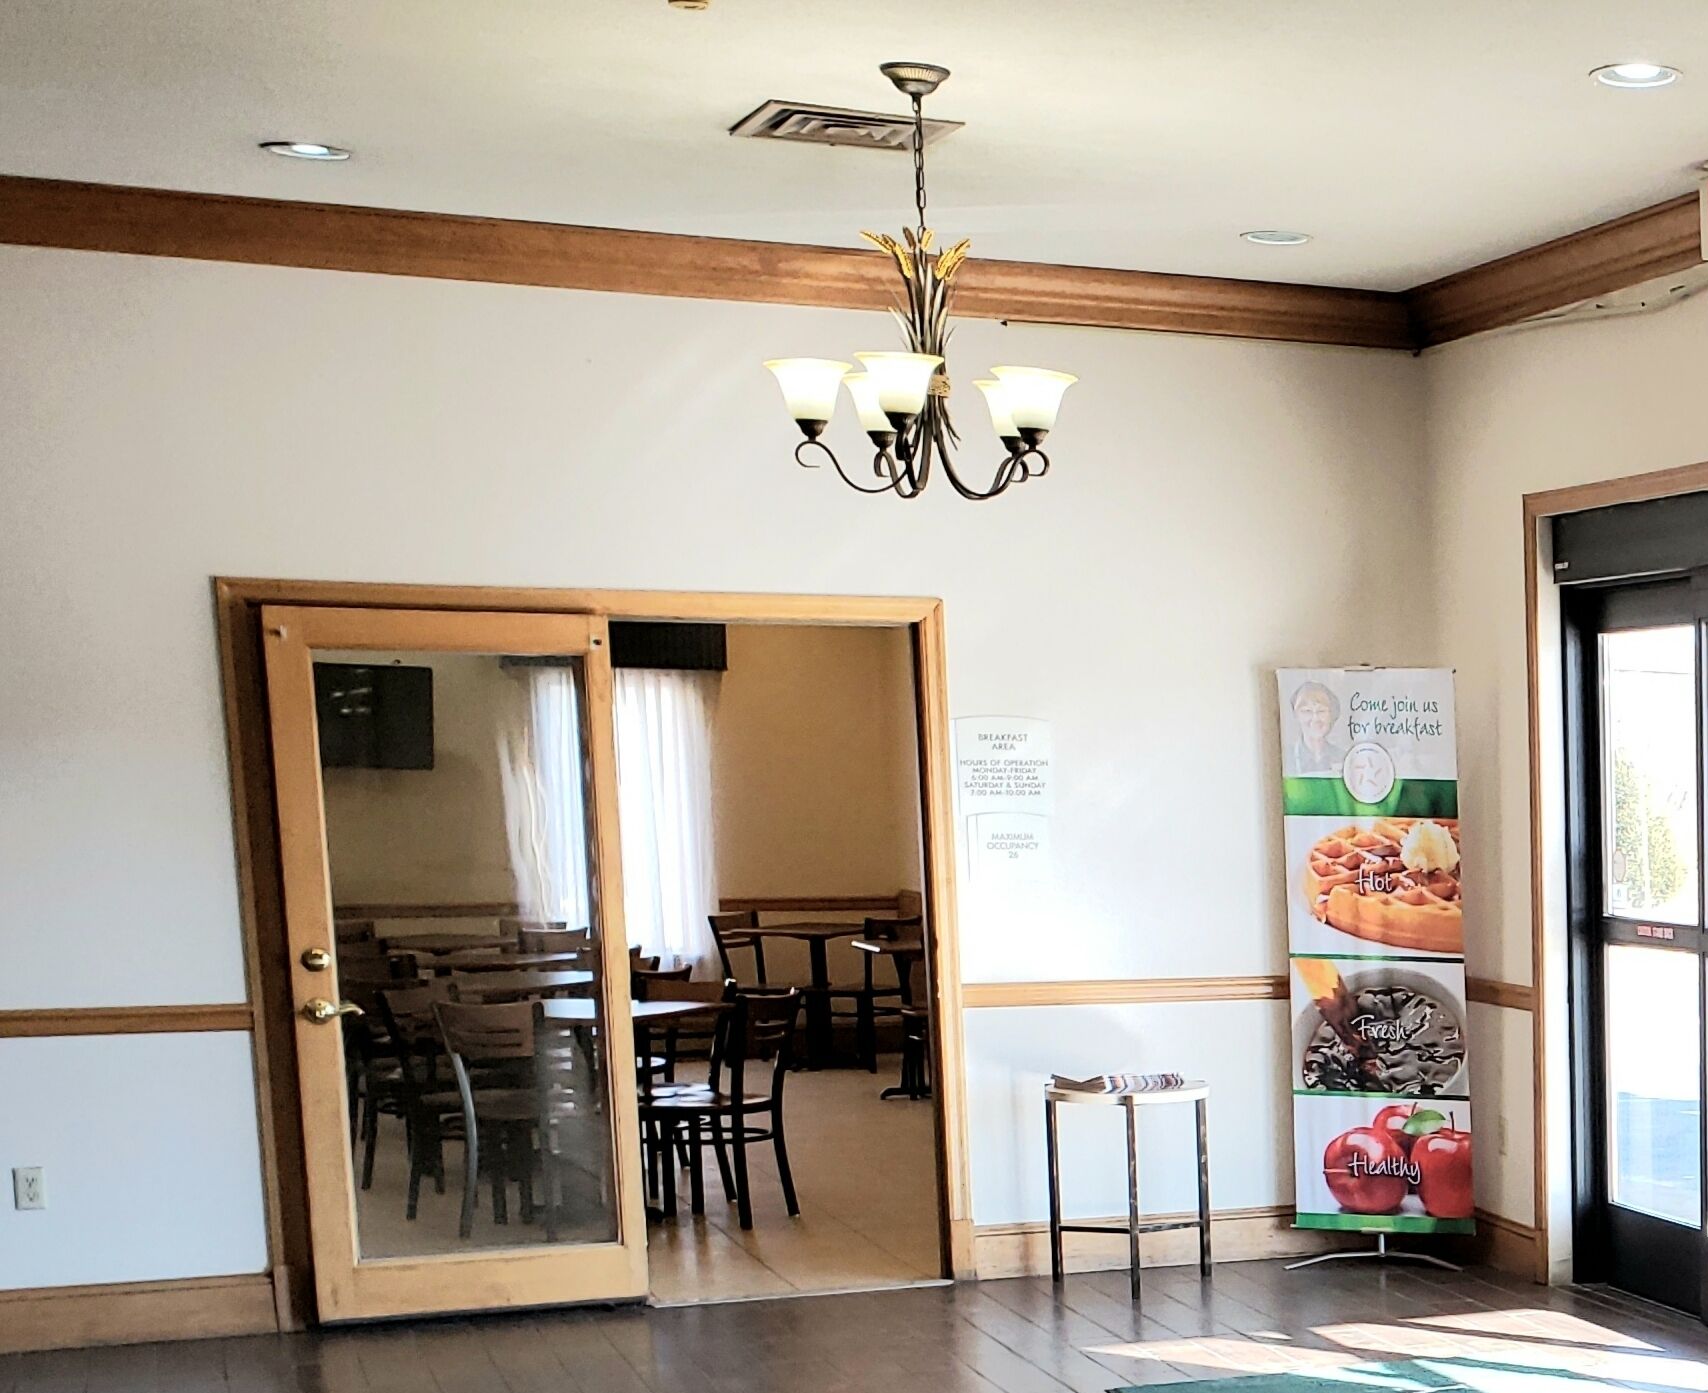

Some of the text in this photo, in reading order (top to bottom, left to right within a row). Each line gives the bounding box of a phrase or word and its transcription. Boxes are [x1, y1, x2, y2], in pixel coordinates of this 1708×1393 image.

[1349, 691, 1438, 720] Come join us
[978, 733, 1028, 742] BREAKFAST
[1347, 715, 1443, 741] for breakfast
[992, 743, 1016, 751] AREA
[987, 842, 1039, 850] OCCUPANCY
[991, 833, 1034, 841] MAXIMUM
[1355, 870, 1393, 894] Hot
[1351, 1014, 1408, 1041] Fresh
[1348, 1152, 1423, 1185] Healthy
